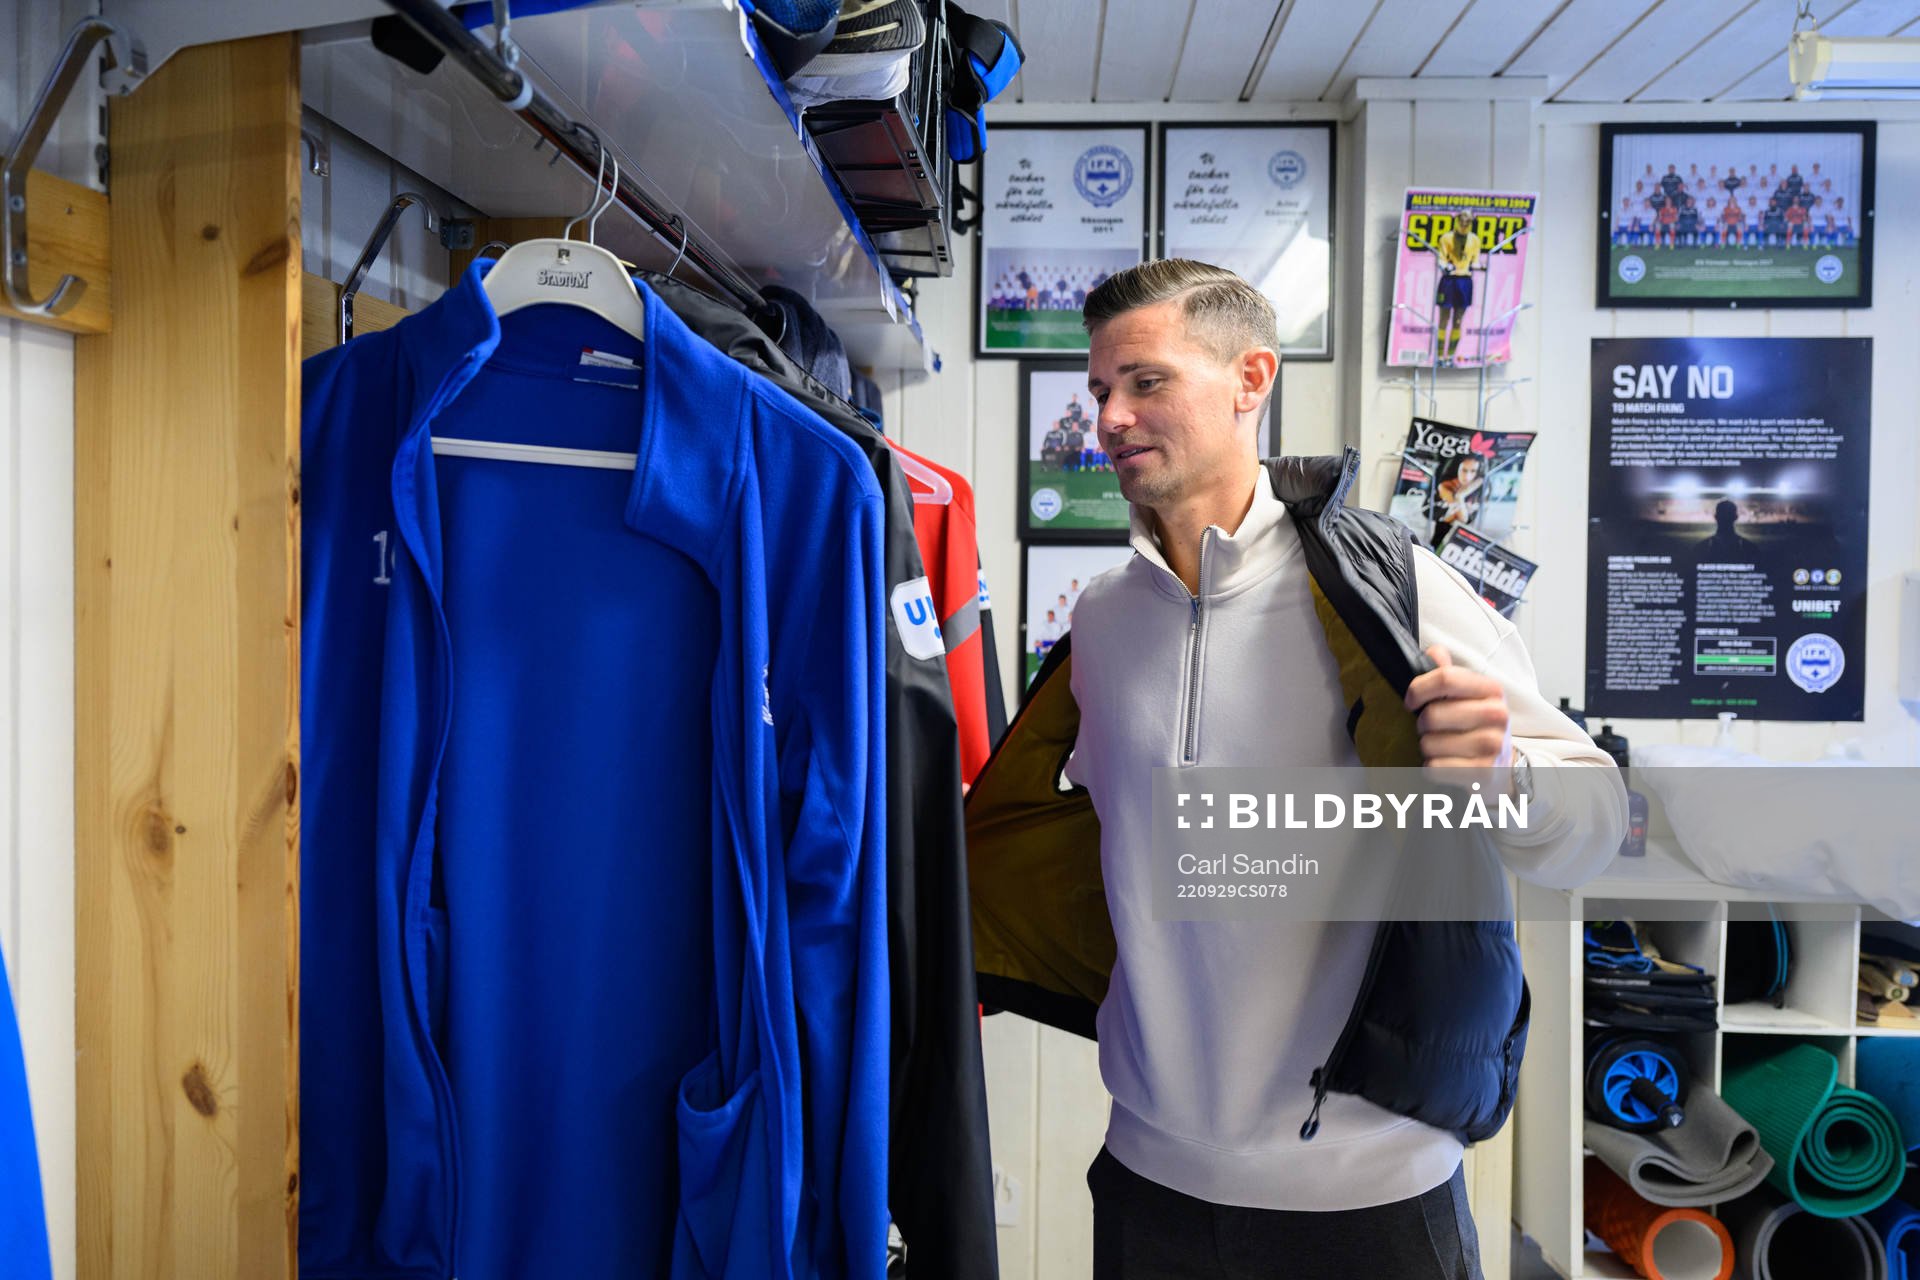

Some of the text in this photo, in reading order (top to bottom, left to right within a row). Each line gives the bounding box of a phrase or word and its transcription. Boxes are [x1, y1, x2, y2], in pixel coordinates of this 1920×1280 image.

[1091, 159, 1115, 169] IFK
[537, 270, 592, 289] STADIUM
[1612, 364, 1734, 399] SAY NO
[1612, 402, 1685, 414] TO MATCH FIXING
[1414, 422, 1471, 458] Yoga
[373, 530, 396, 585] 1
[1440, 542, 1528, 598] offside
[1792, 600, 1841, 612] UNIBET
